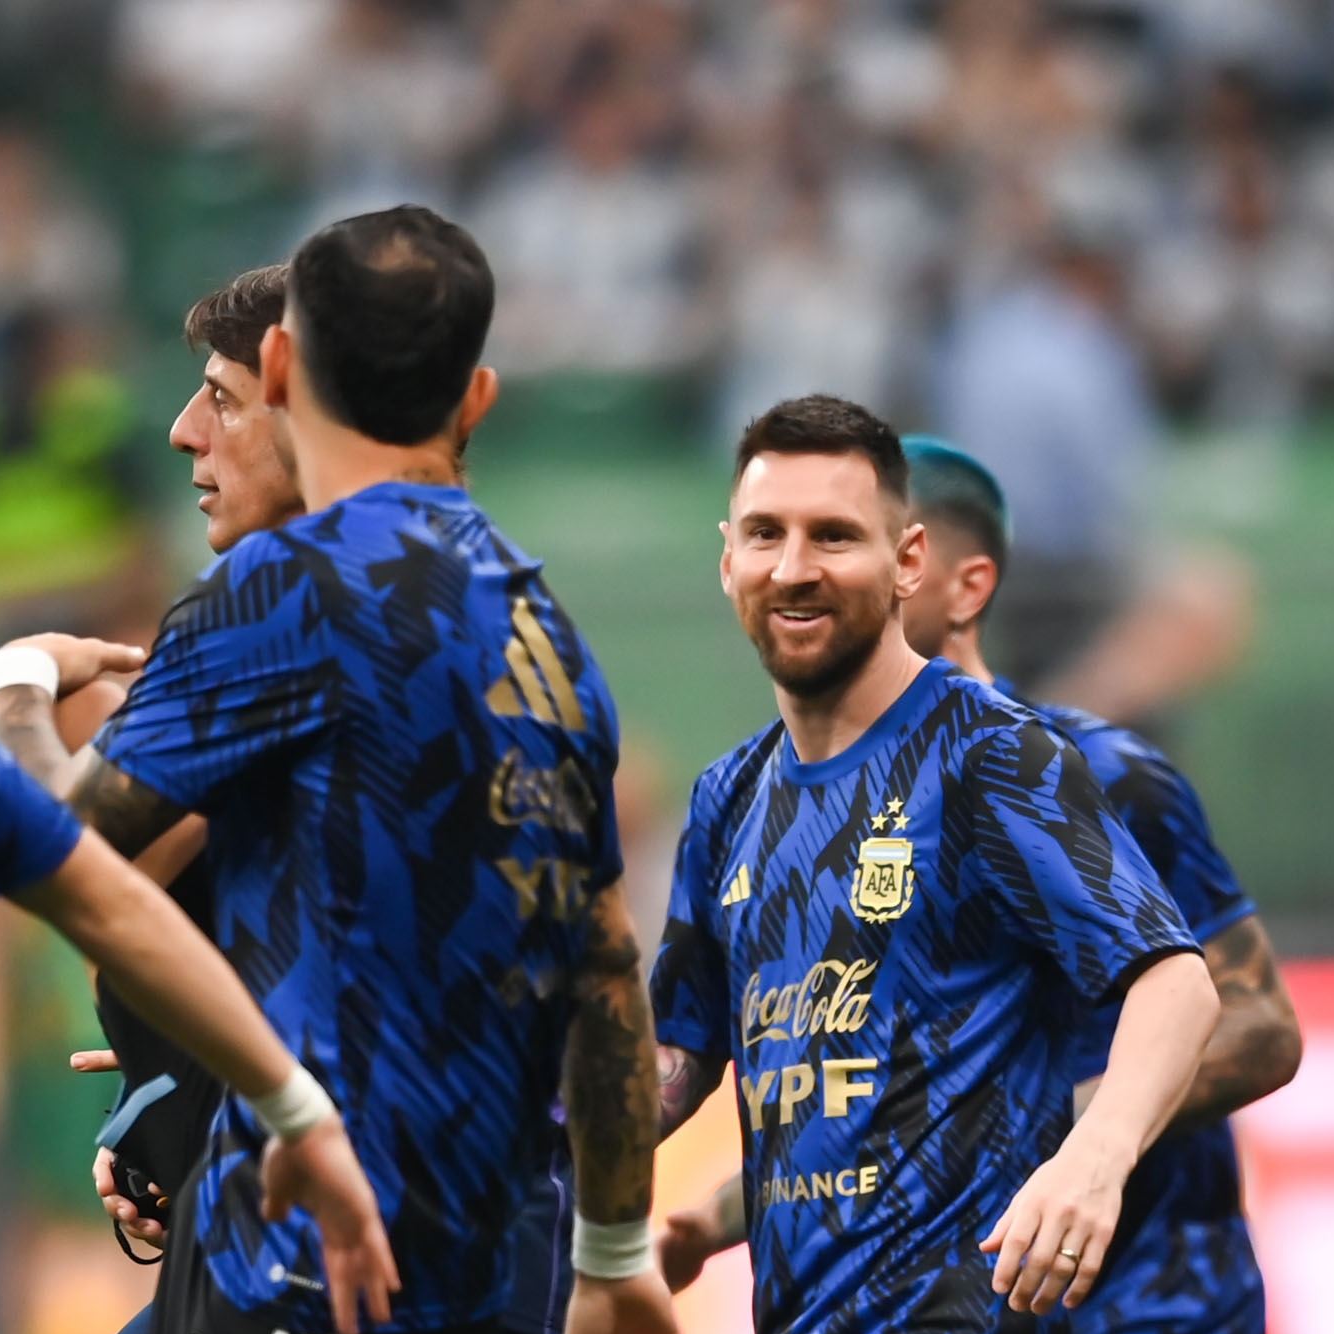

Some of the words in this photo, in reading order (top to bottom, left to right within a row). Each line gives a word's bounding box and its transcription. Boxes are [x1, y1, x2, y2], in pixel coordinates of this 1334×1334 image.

[865, 862, 897, 898] AFA
[741, 1057, 878, 1132] YPF
[762, 1165, 879, 1206] BINANCE
